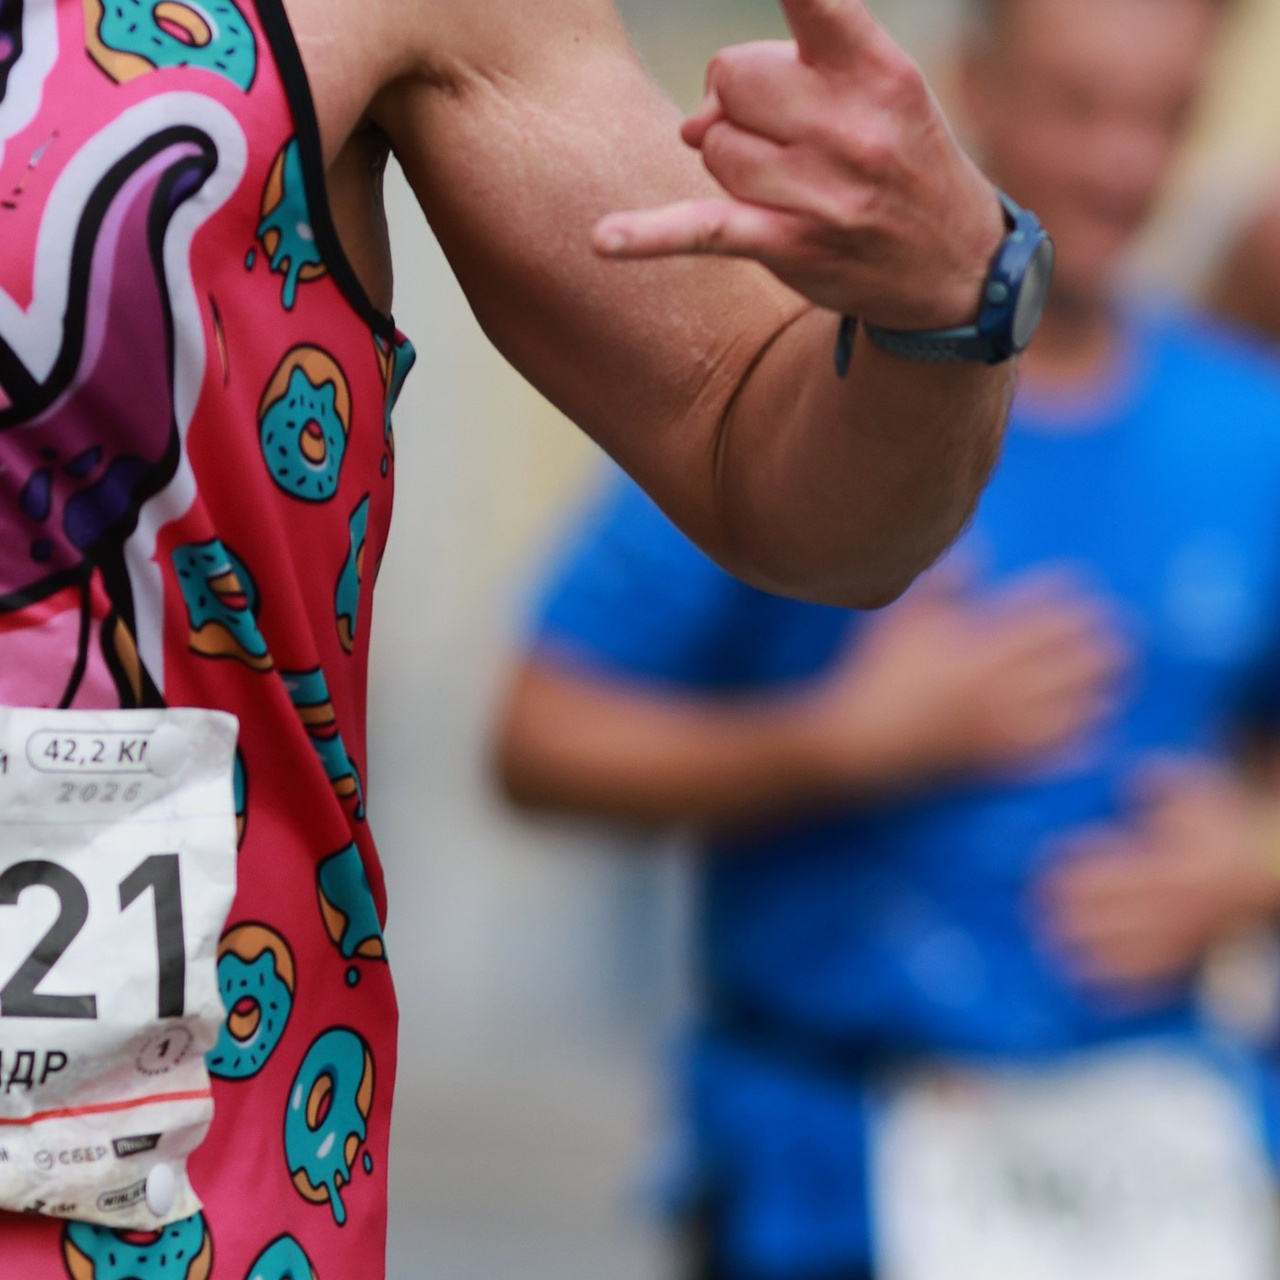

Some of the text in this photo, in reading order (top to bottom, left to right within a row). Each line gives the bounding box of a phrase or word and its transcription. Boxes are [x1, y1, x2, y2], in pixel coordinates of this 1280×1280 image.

[43, 739, 106, 767] 42,2
[55, 781, 143, 803] 2026
[58, 1146, 108, 1166] СБЕР
